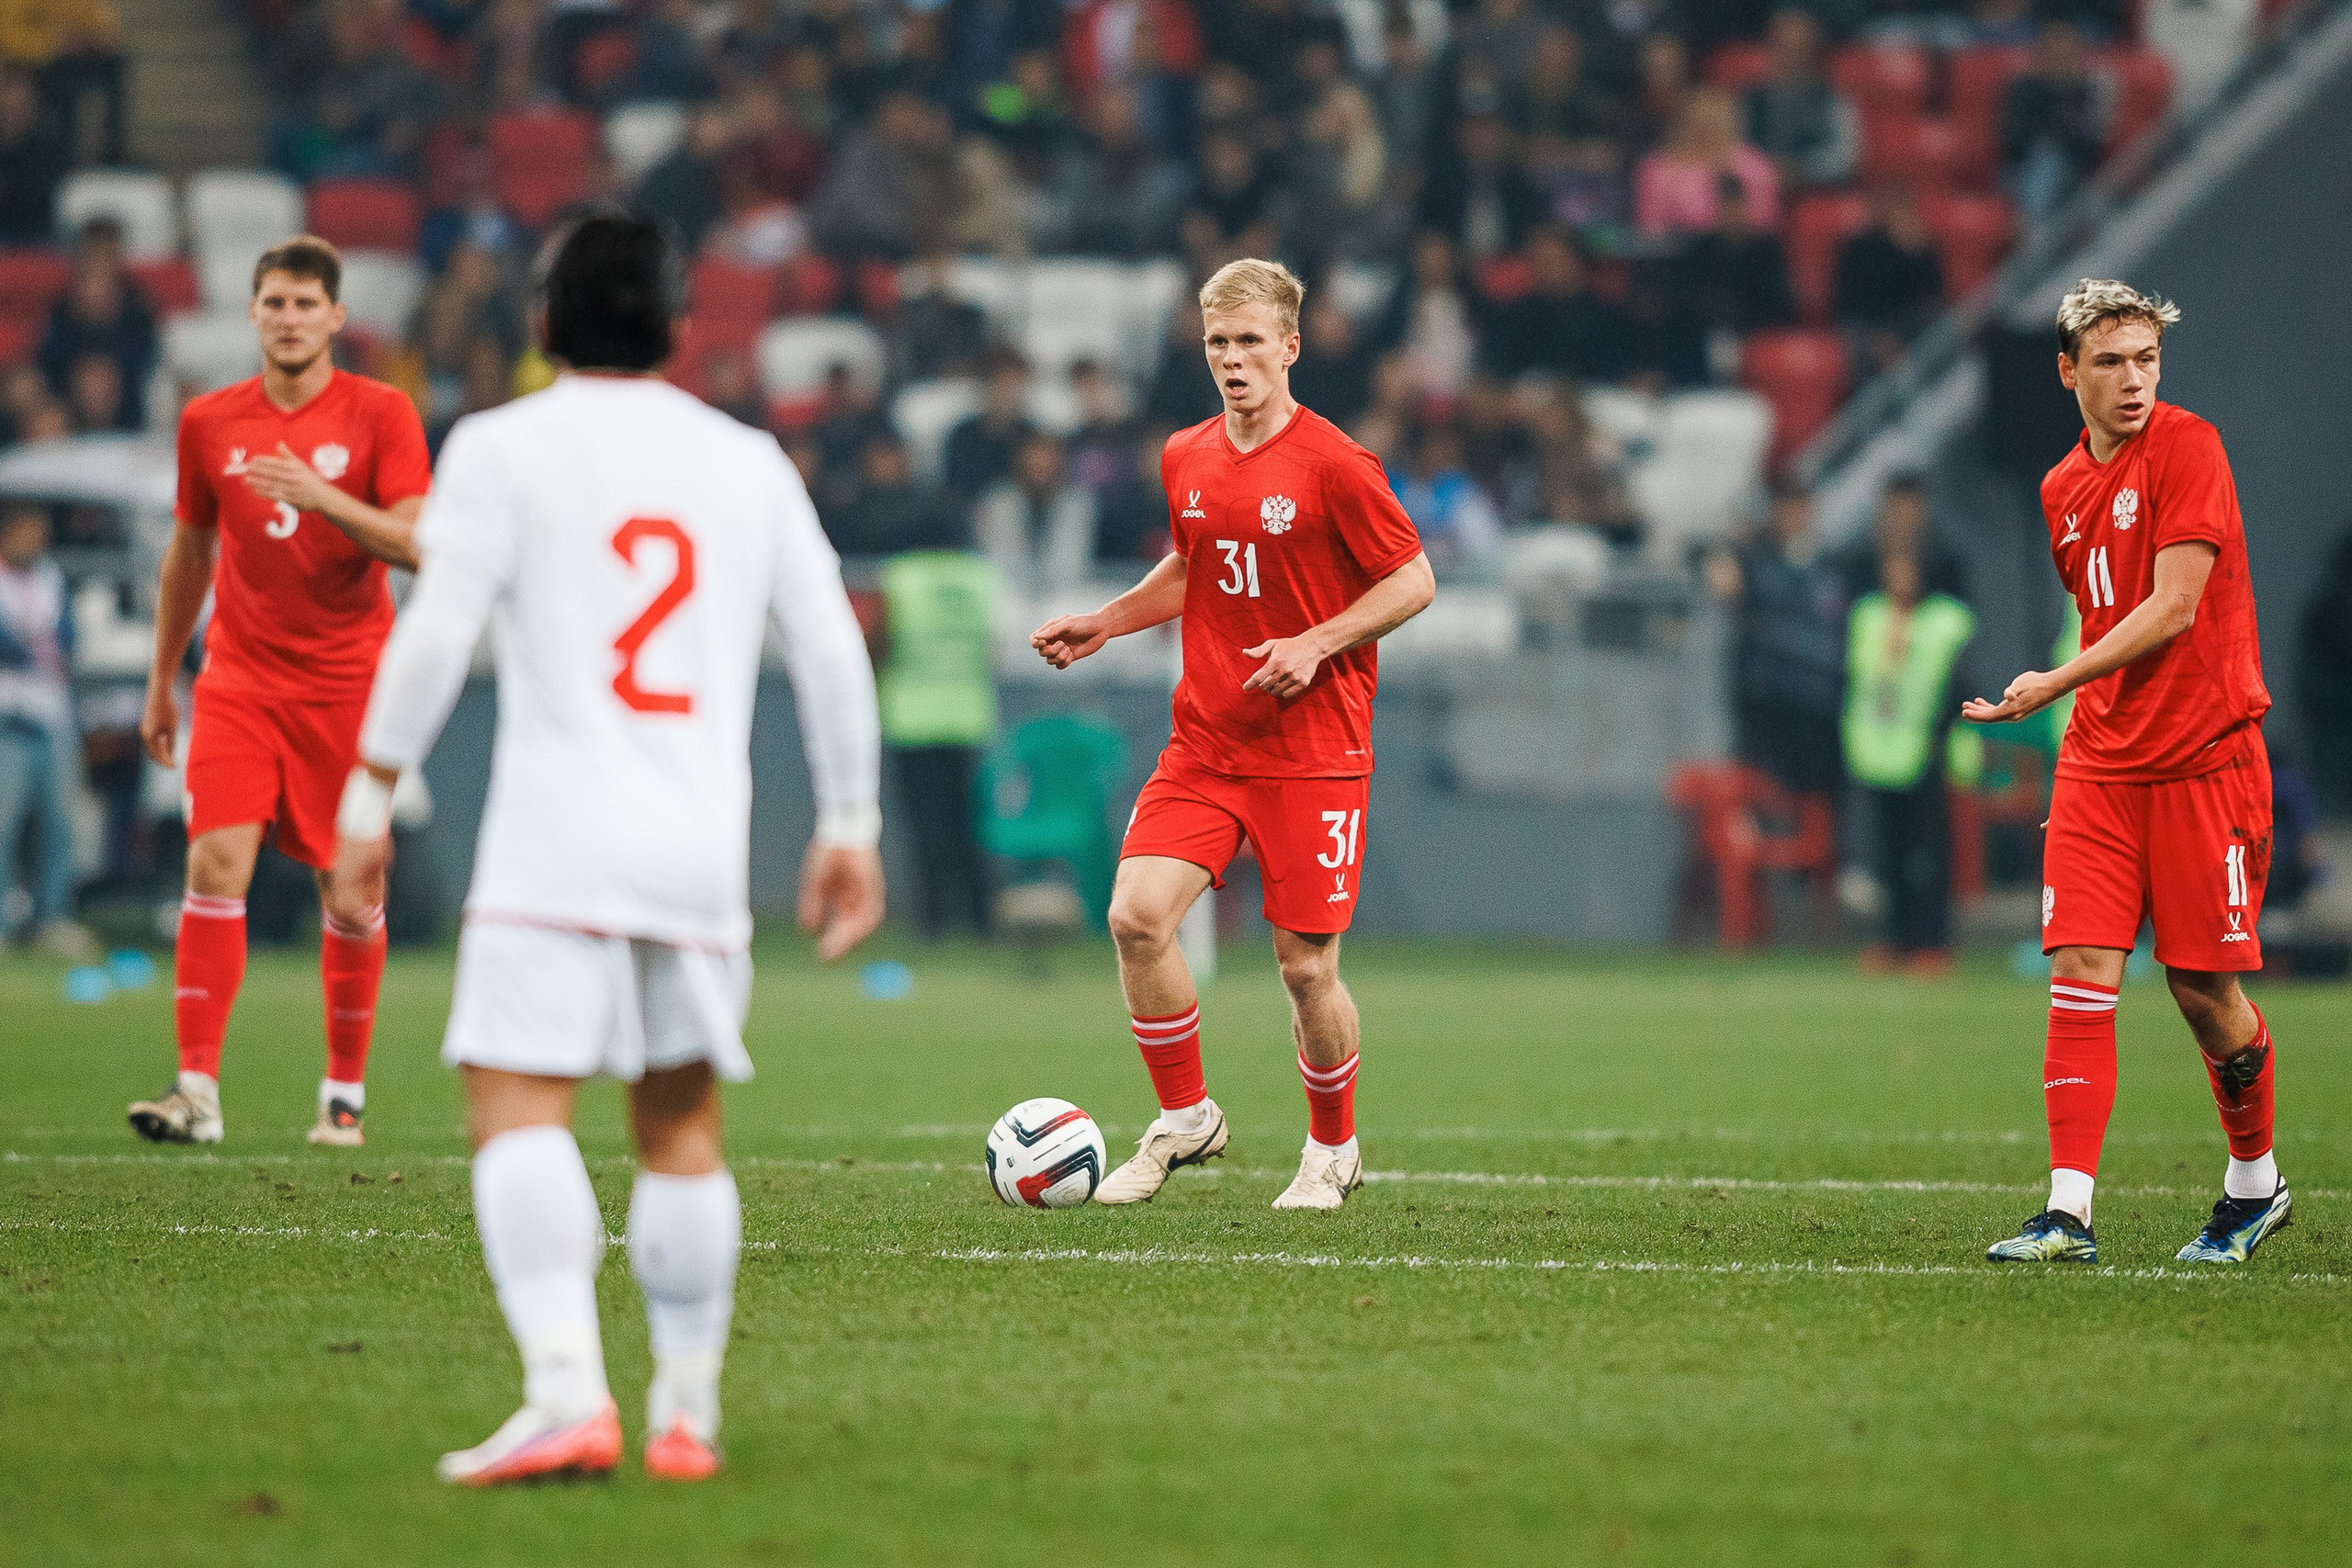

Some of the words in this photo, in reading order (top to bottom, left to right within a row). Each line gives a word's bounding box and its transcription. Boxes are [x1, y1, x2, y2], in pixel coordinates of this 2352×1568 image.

[1216, 538, 1261, 598] 31
[2086, 546, 2115, 608] 11
[611, 516, 695, 716] 2
[1316, 808, 1361, 869] 31
[2224, 844, 2248, 907] 11
